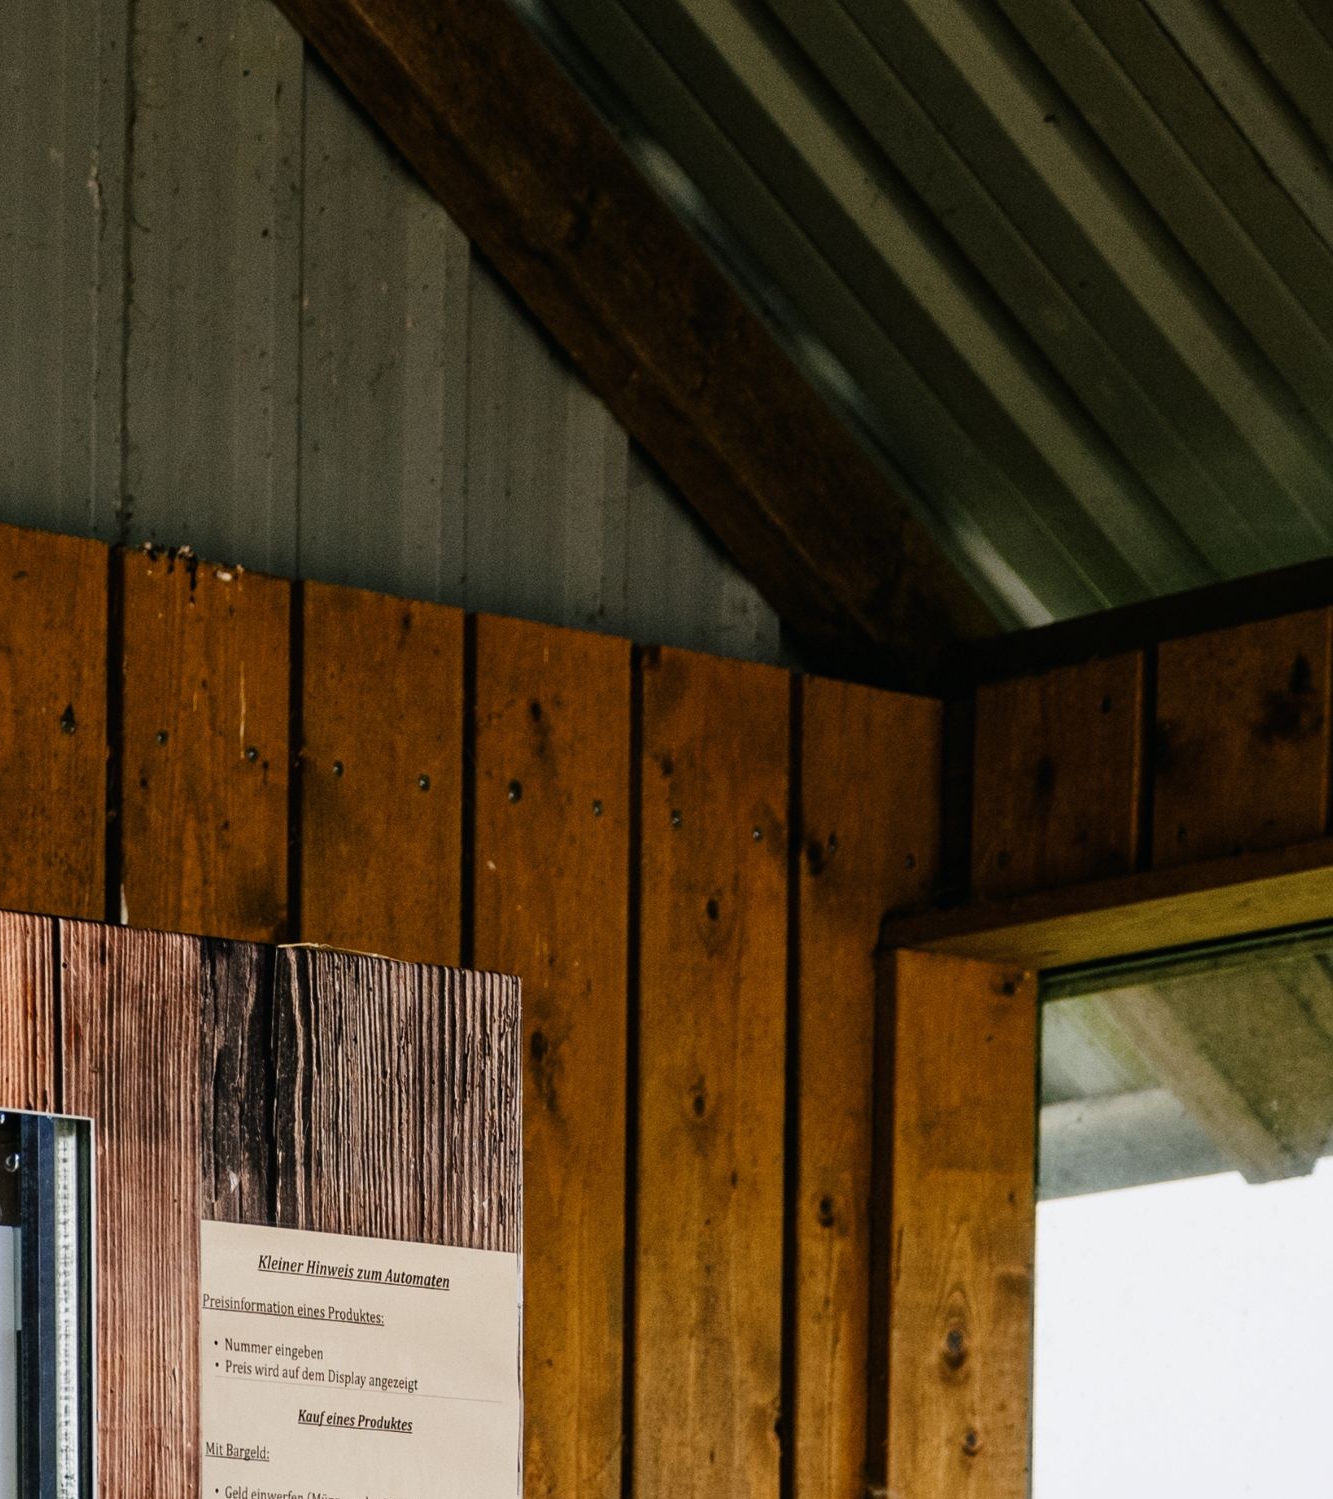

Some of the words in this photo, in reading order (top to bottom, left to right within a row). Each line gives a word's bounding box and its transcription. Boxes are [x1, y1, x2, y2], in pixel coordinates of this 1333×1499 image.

[257, 1255, 304, 1274] Kleiner
[306, 1260, 354, 1279] Hinweis
[357, 1269, 382, 1281] zum
[384, 1269, 450, 1288] Automaten
[203, 1294, 294, 1315] Preisinformation
[297, 1304, 325, 1318] eines
[328, 1306, 384, 1324] Produktes:
[225, 1338, 273, 1355] Nummer
[275, 1344, 323, 1361] eingeben
[226, 1360, 252, 1375] Preis
[255, 1364, 279, 1377] wird
[282, 1366, 300, 1381] auf
[302, 1367, 324, 1381] dem
[328, 1369, 366, 1389] Display
[369, 1377, 418, 1393] angezeigt
[298, 1409, 326, 1425] Kauf
[327, 1412, 355, 1427] eines
[357, 1414, 413, 1432] Produktes
[206, 1442, 223, 1456] Mit
[226, 1443, 269, 1459] Bargeld:
[225, 1486, 248, 1499] Geld
